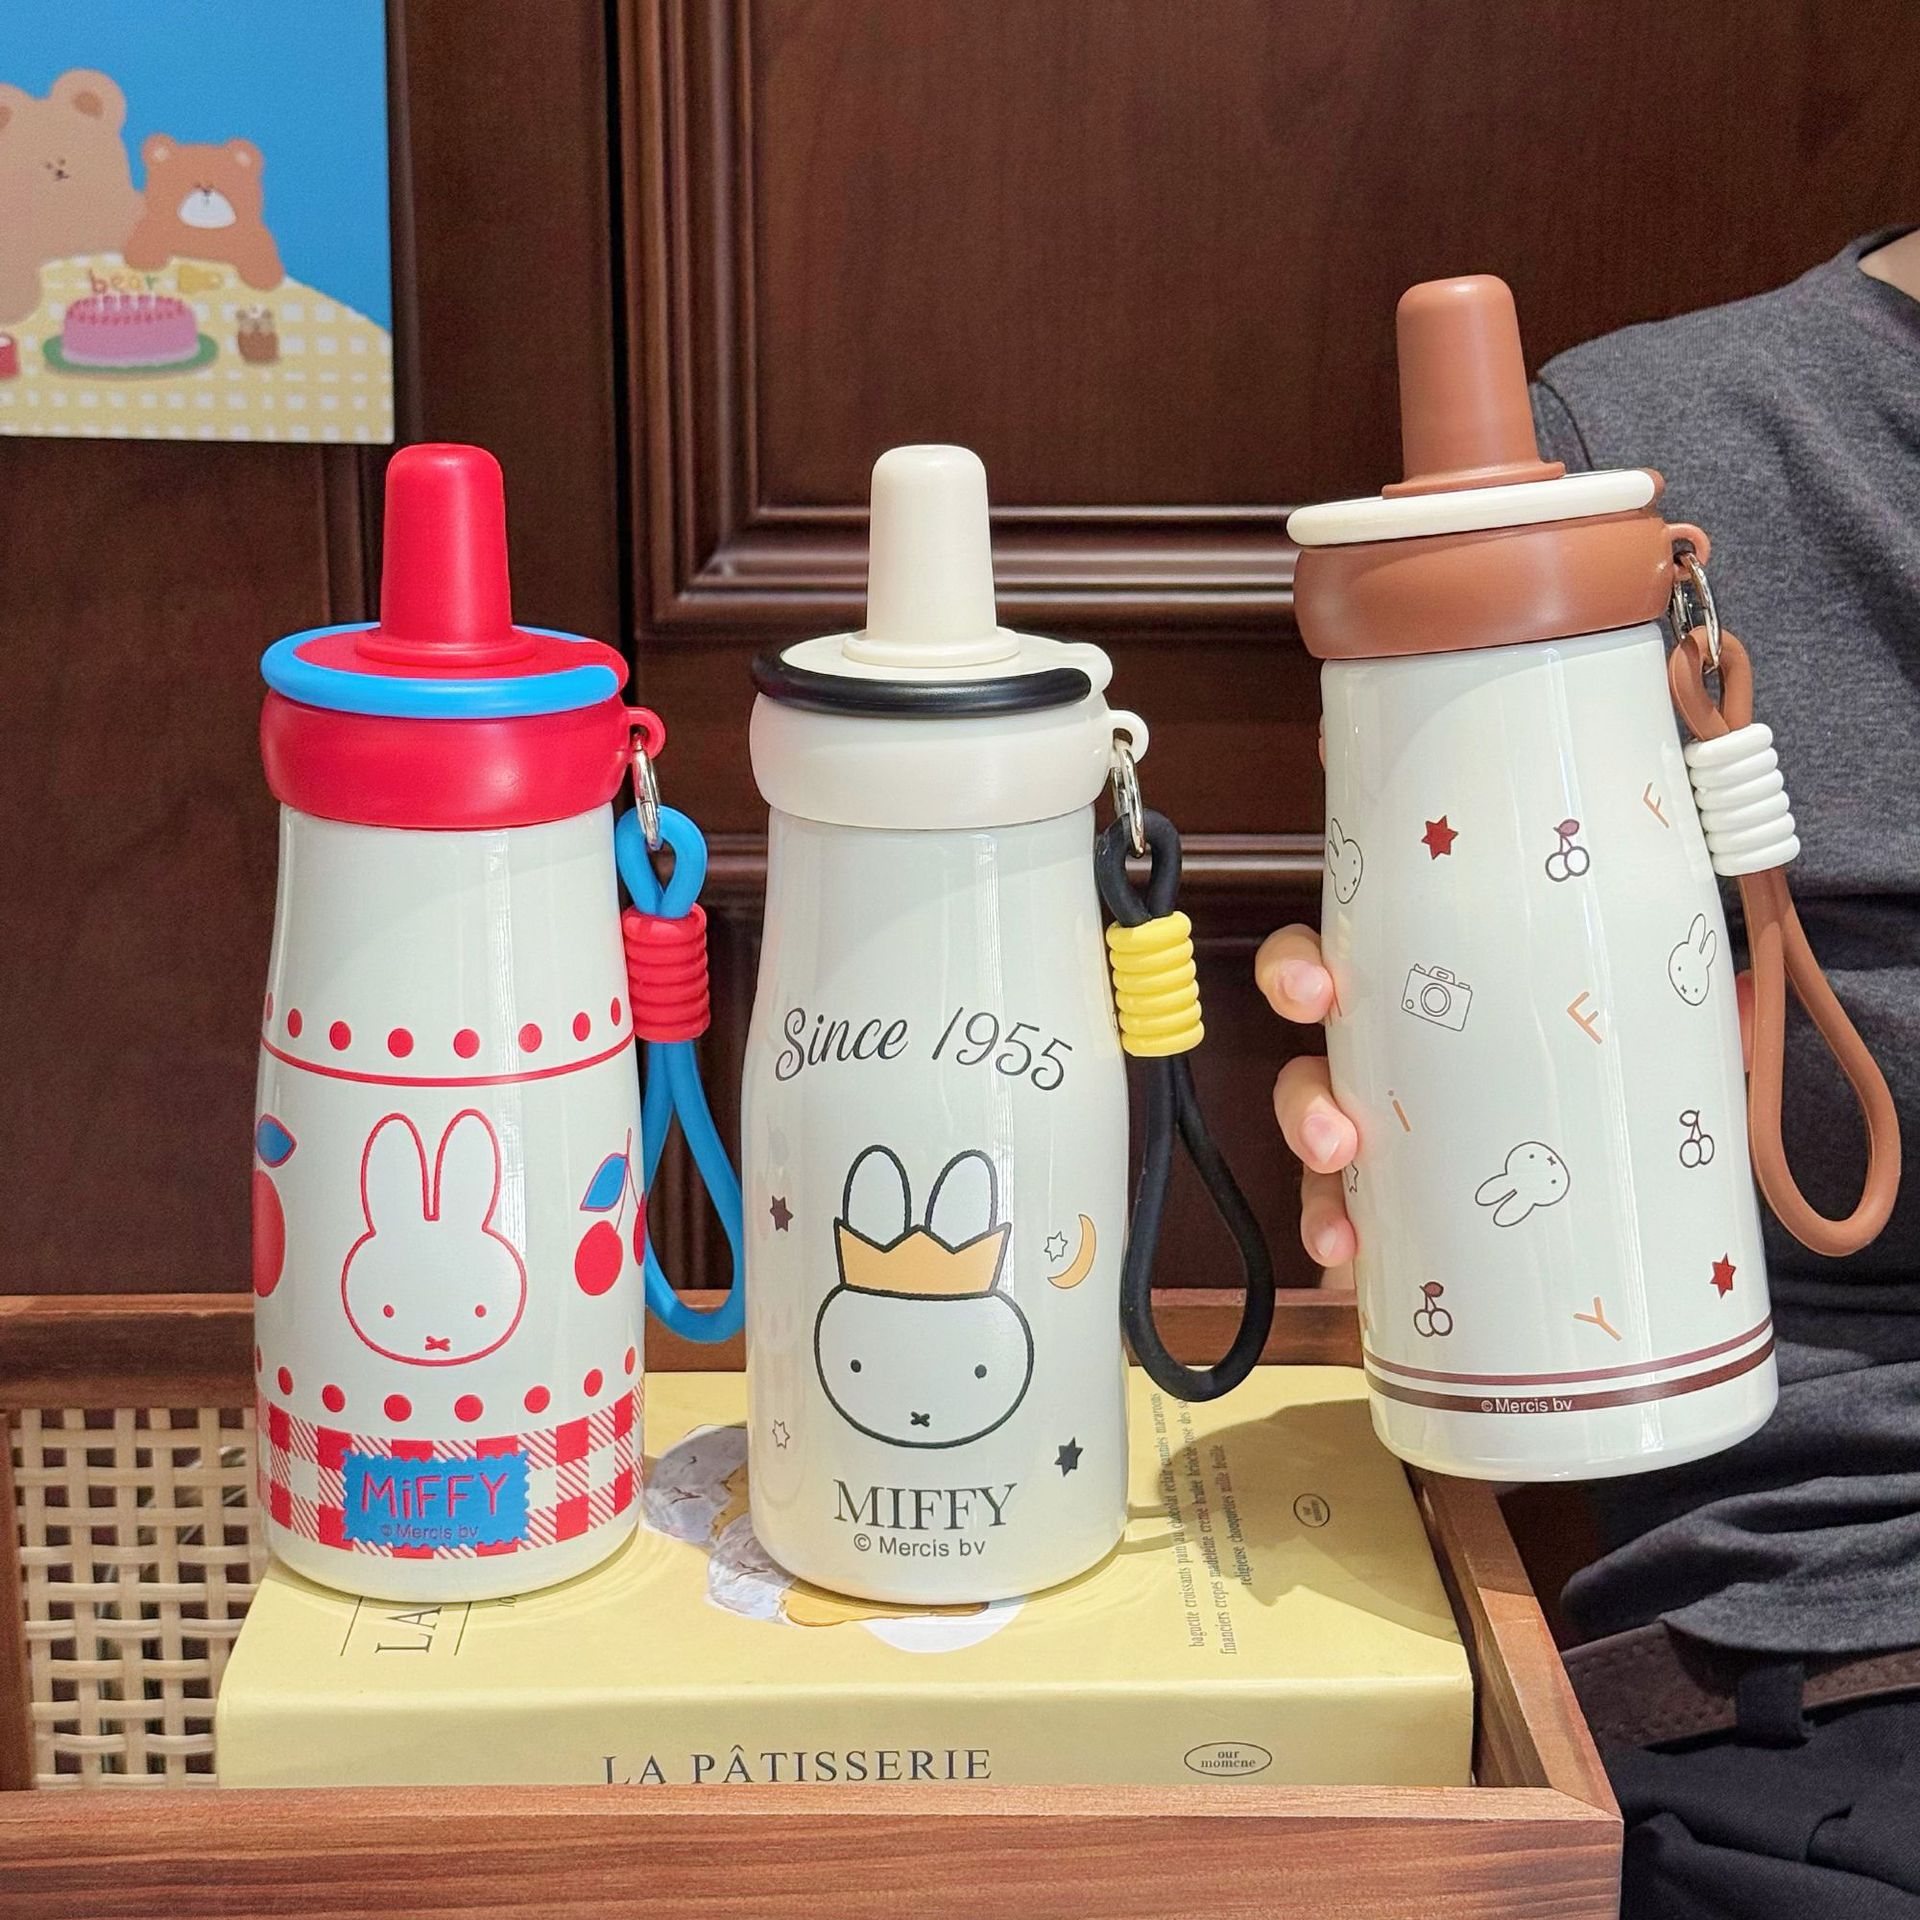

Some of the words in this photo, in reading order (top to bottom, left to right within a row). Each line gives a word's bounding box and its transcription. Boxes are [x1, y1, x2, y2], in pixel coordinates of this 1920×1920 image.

[1567, 991, 1602, 1044] F
[775, 1007, 908, 1081] Since
[931, 1007, 1073, 1090] 1955
[1573, 1296, 1622, 1341] Y
[1552, 1397, 1573, 1411] bv
[833, 1479, 1017, 1530] MIFFY
[1163, 1495, 1183, 1529] chocolat
[396, 1523, 452, 1540] Mercis
[458, 1523, 479, 1538] bv
[879, 1536, 949, 1557] Mercis
[959, 1538, 985, 1556] bv
[1173, 1531, 1184, 1541] au
[1172, 1545, 1193, 1563] pain
[1200, 1536, 1220, 1577] madeleine
[1233, 1546, 1254, 1585] religieuse
[1178, 1567, 1197, 1608] croissants
[374, 1606, 442, 1653] LA
[1186, 1611, 1207, 1647] baguette
[1216, 1611, 1237, 1654] financiers
[601, 1755, 666, 1784] LA
[690, 1744, 992, 1784] PÂTISSERIE
[1217, 1751, 1240, 1759] our
